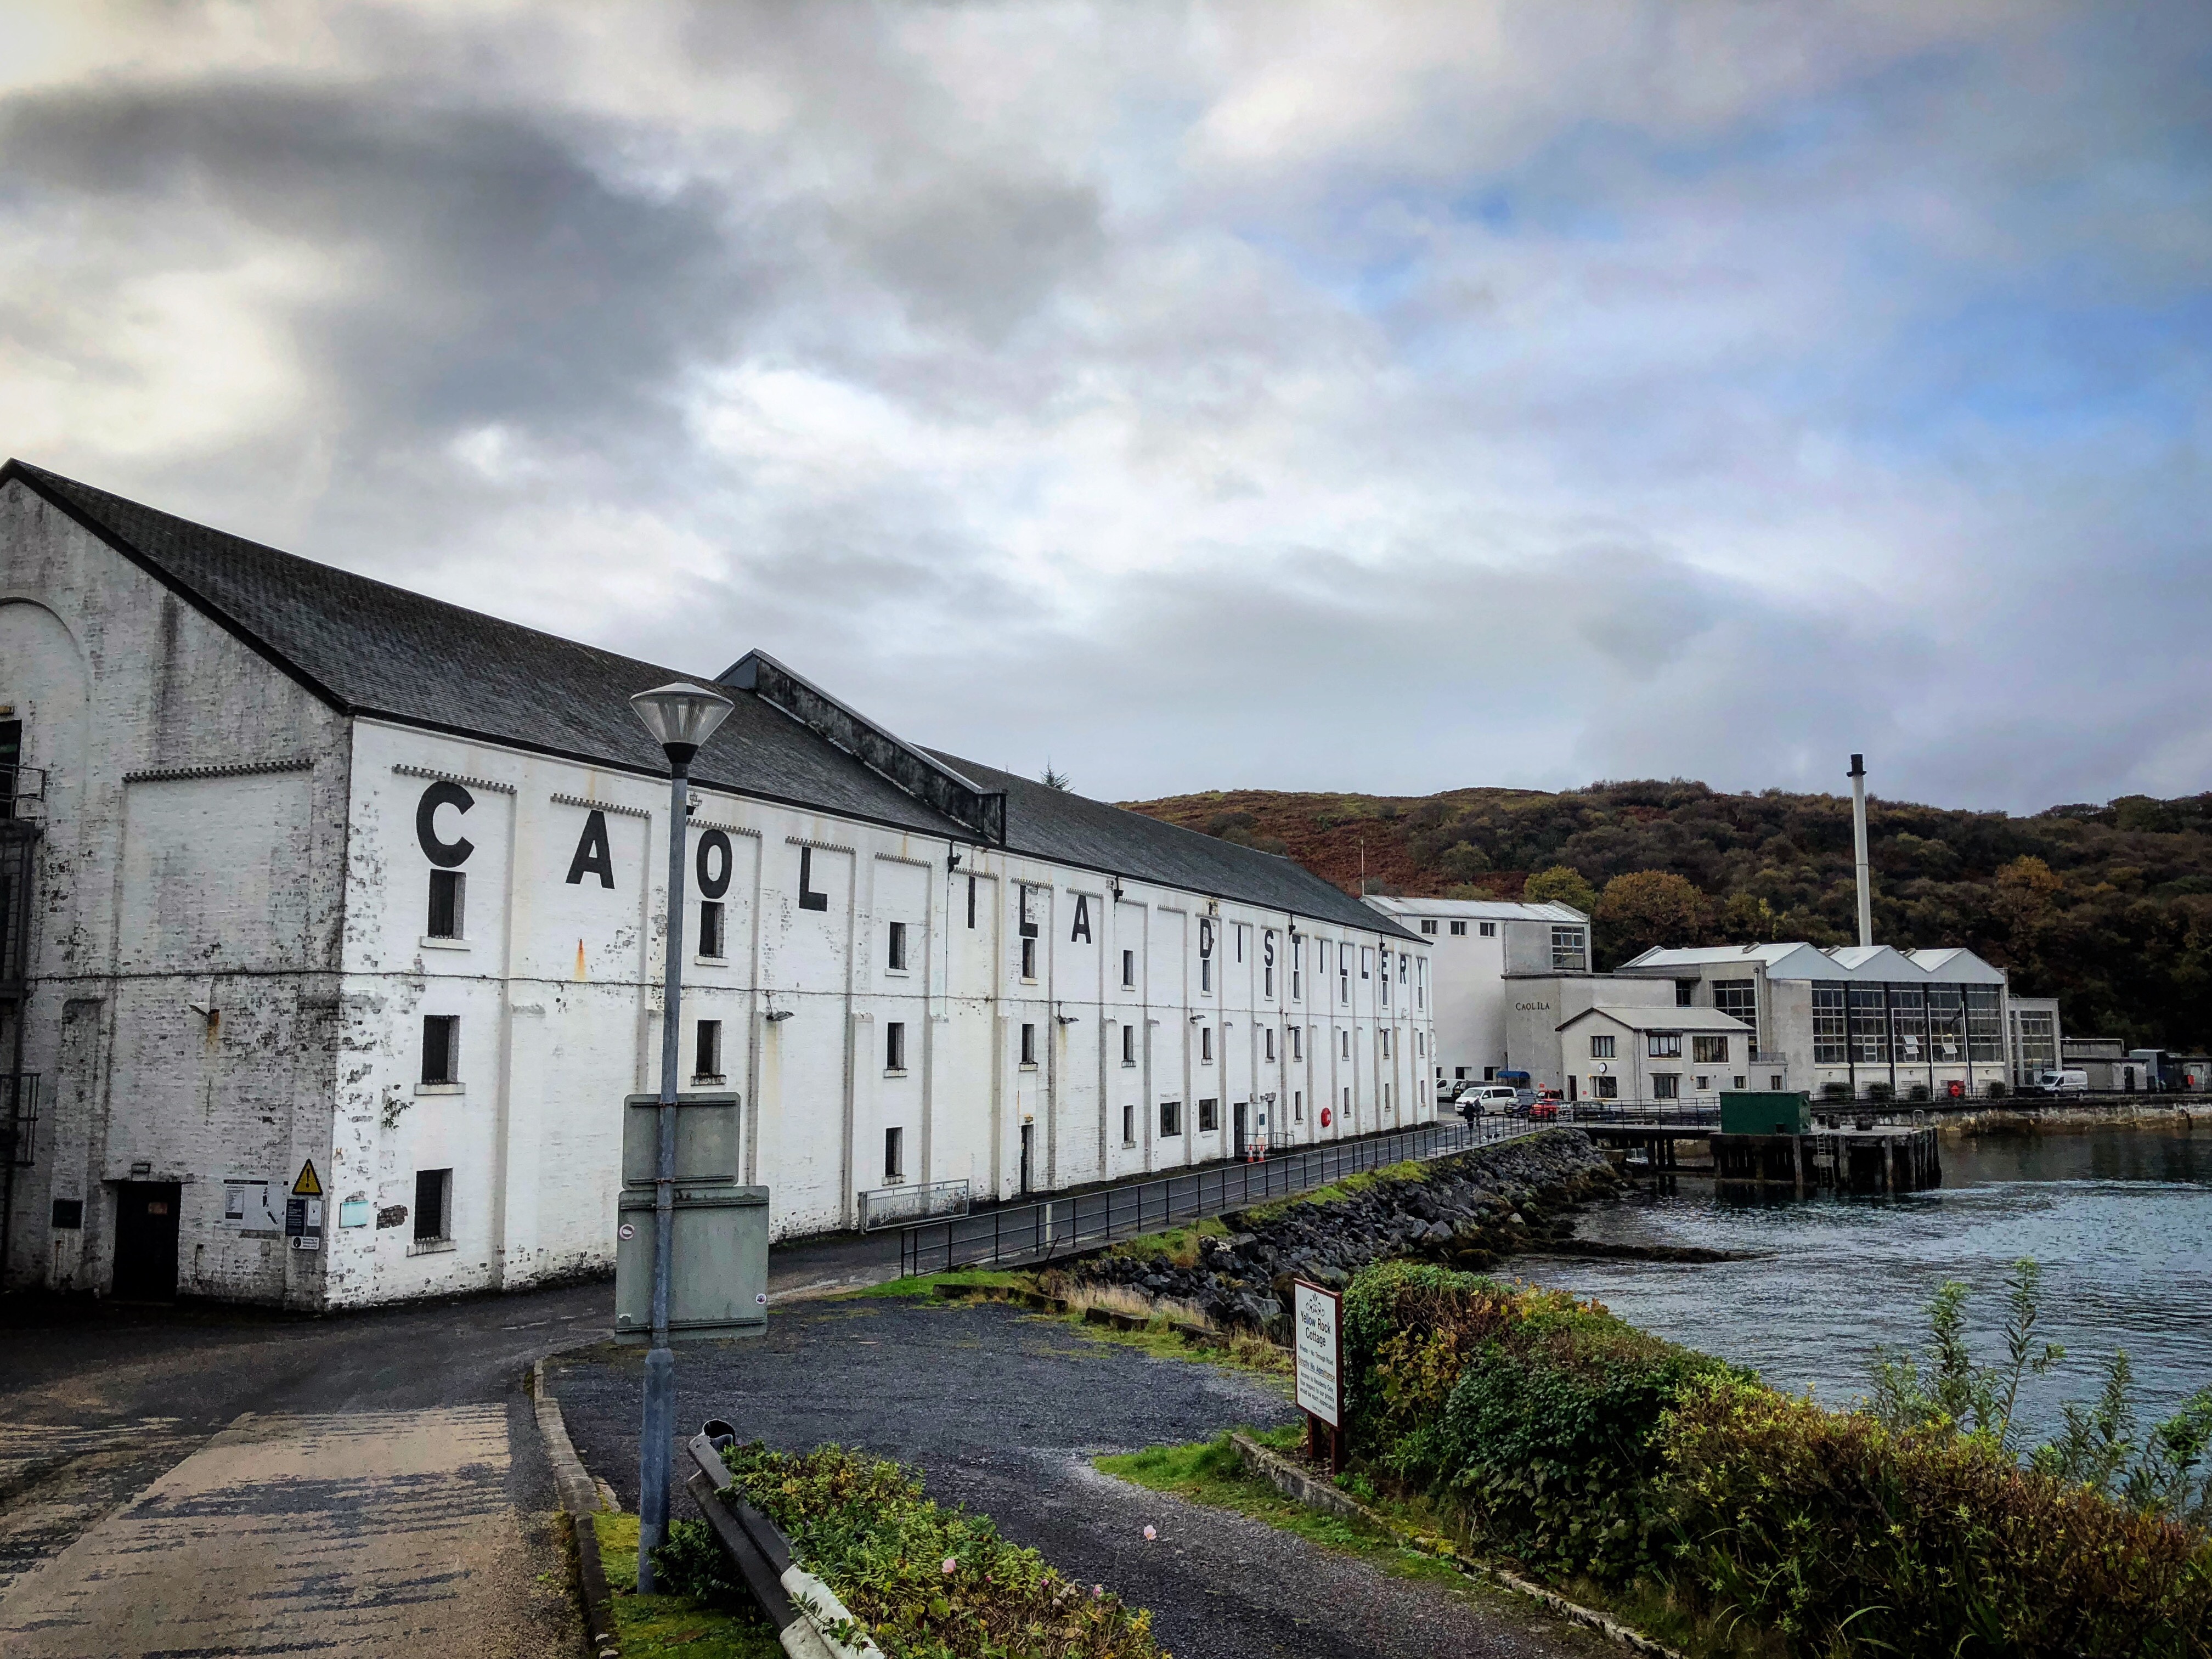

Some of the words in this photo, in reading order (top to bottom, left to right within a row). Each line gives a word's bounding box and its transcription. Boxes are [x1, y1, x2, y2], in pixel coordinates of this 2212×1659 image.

[416, 780, 827, 912] CAOL
[968, 876, 1092, 944] ILA
[1200, 918, 1423, 986] DISTILLERY
[1516, 1002, 1536, 1011] CAOL
[1537, 1002, 1550, 1010] ILA
[1300, 1310, 1316, 1327] Yellow
[1318, 1318, 1331, 1334] Rock
[1306, 1327, 1326, 1347] Cottage
